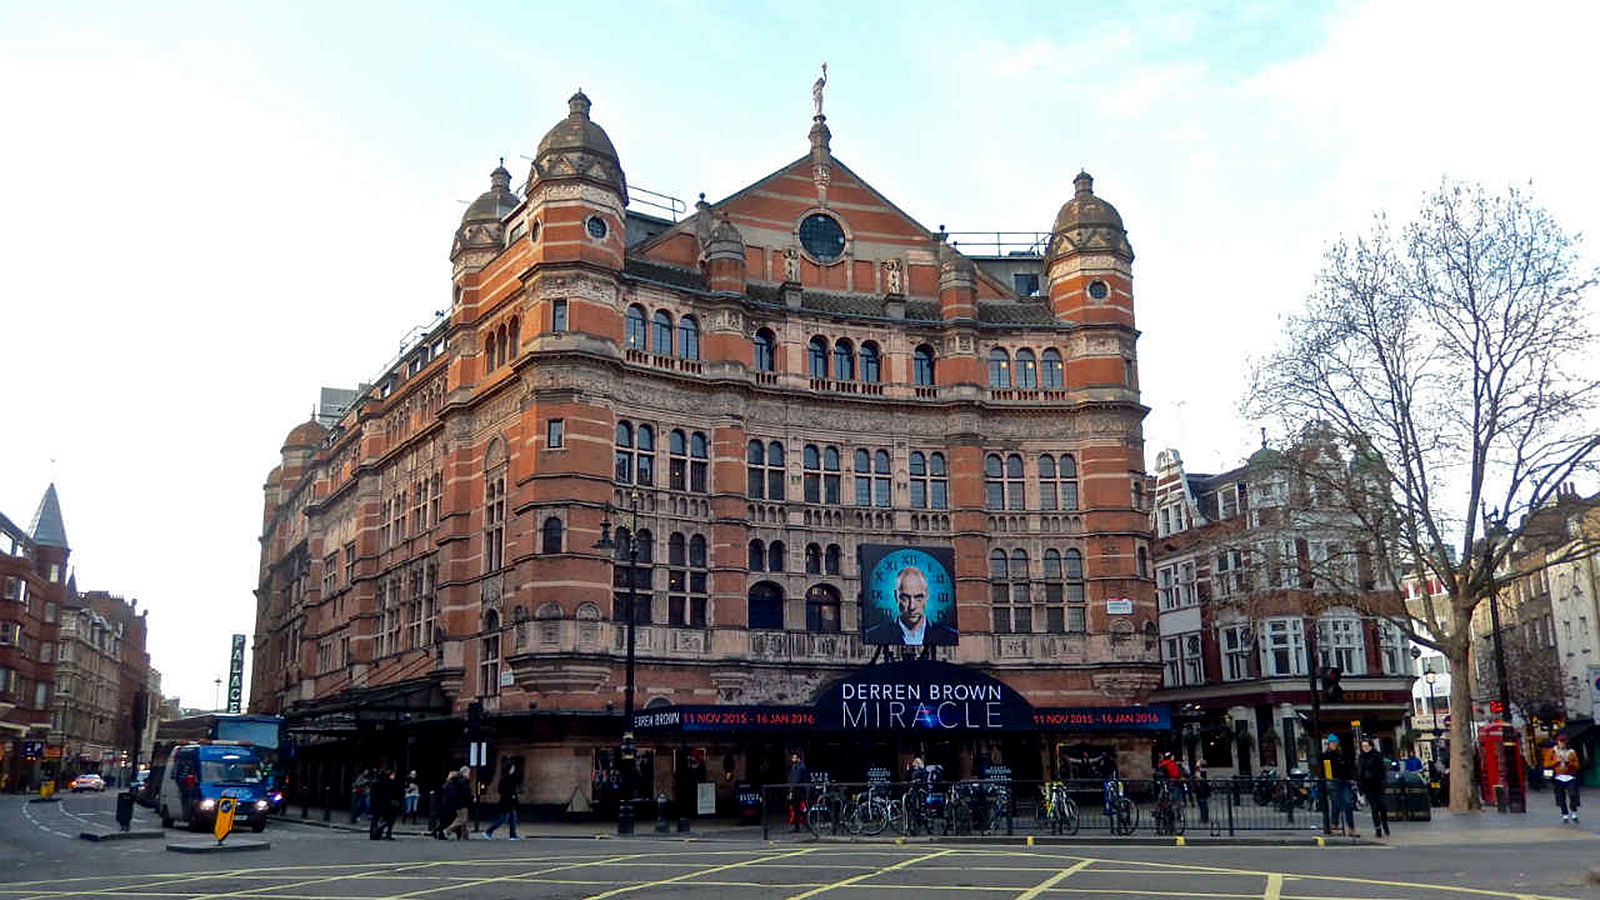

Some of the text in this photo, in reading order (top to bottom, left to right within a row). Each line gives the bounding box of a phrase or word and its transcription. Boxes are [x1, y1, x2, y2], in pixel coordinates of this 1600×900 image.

[229, 636, 244, 713] PALACE
[842, 683, 1001, 700] DERREN BROWN
[633, 714, 654, 729] ERREN
[654, 711, 680, 727] BROWN
[682, 712, 694, 724] 11
[696, 712, 721, 724] NOV
[722, 712, 748, 724] 2015
[755, 712, 769, 724] 16
[770, 712, 790, 724] JAN
[790, 712, 815, 724] 2016
[842, 700, 1003, 729] MIRACLE
[1033, 714, 1045, 724] 11
[1046, 714, 1069, 724] NOV
[1070, 714, 1094, 724] 2015
[1102, 713, 1111, 724] 16
[1115, 713, 1134, 724] JAN
[1135, 712, 1159, 724] 2016
